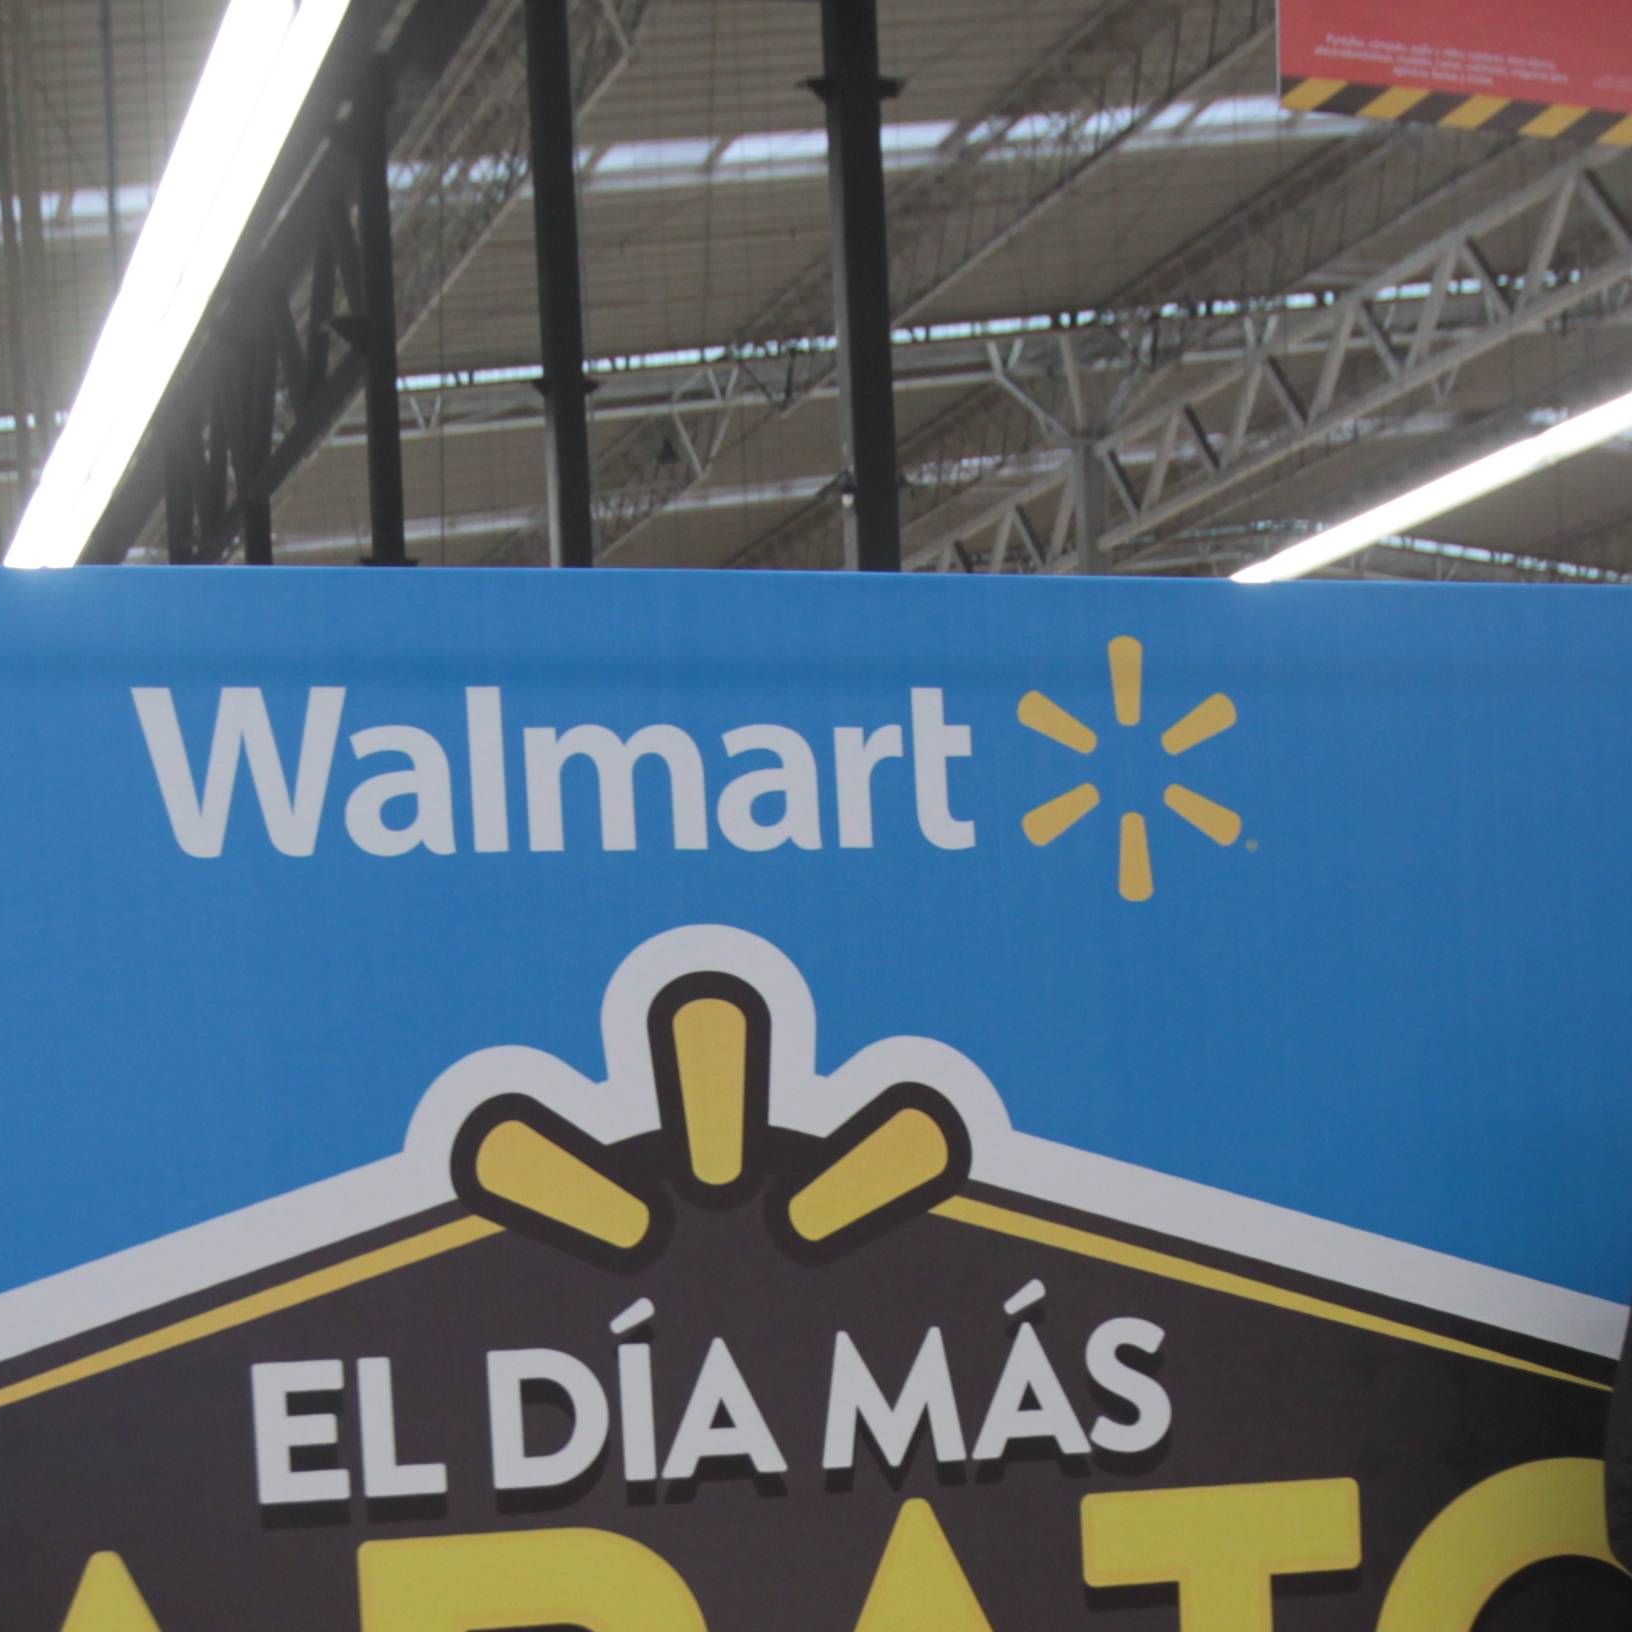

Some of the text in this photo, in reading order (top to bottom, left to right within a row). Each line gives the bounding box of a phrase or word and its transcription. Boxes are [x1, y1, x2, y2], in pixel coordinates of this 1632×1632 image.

[131, 685, 976, 860] Walmart
[251, 1277, 1174, 1507] EL DÍA MÁS
